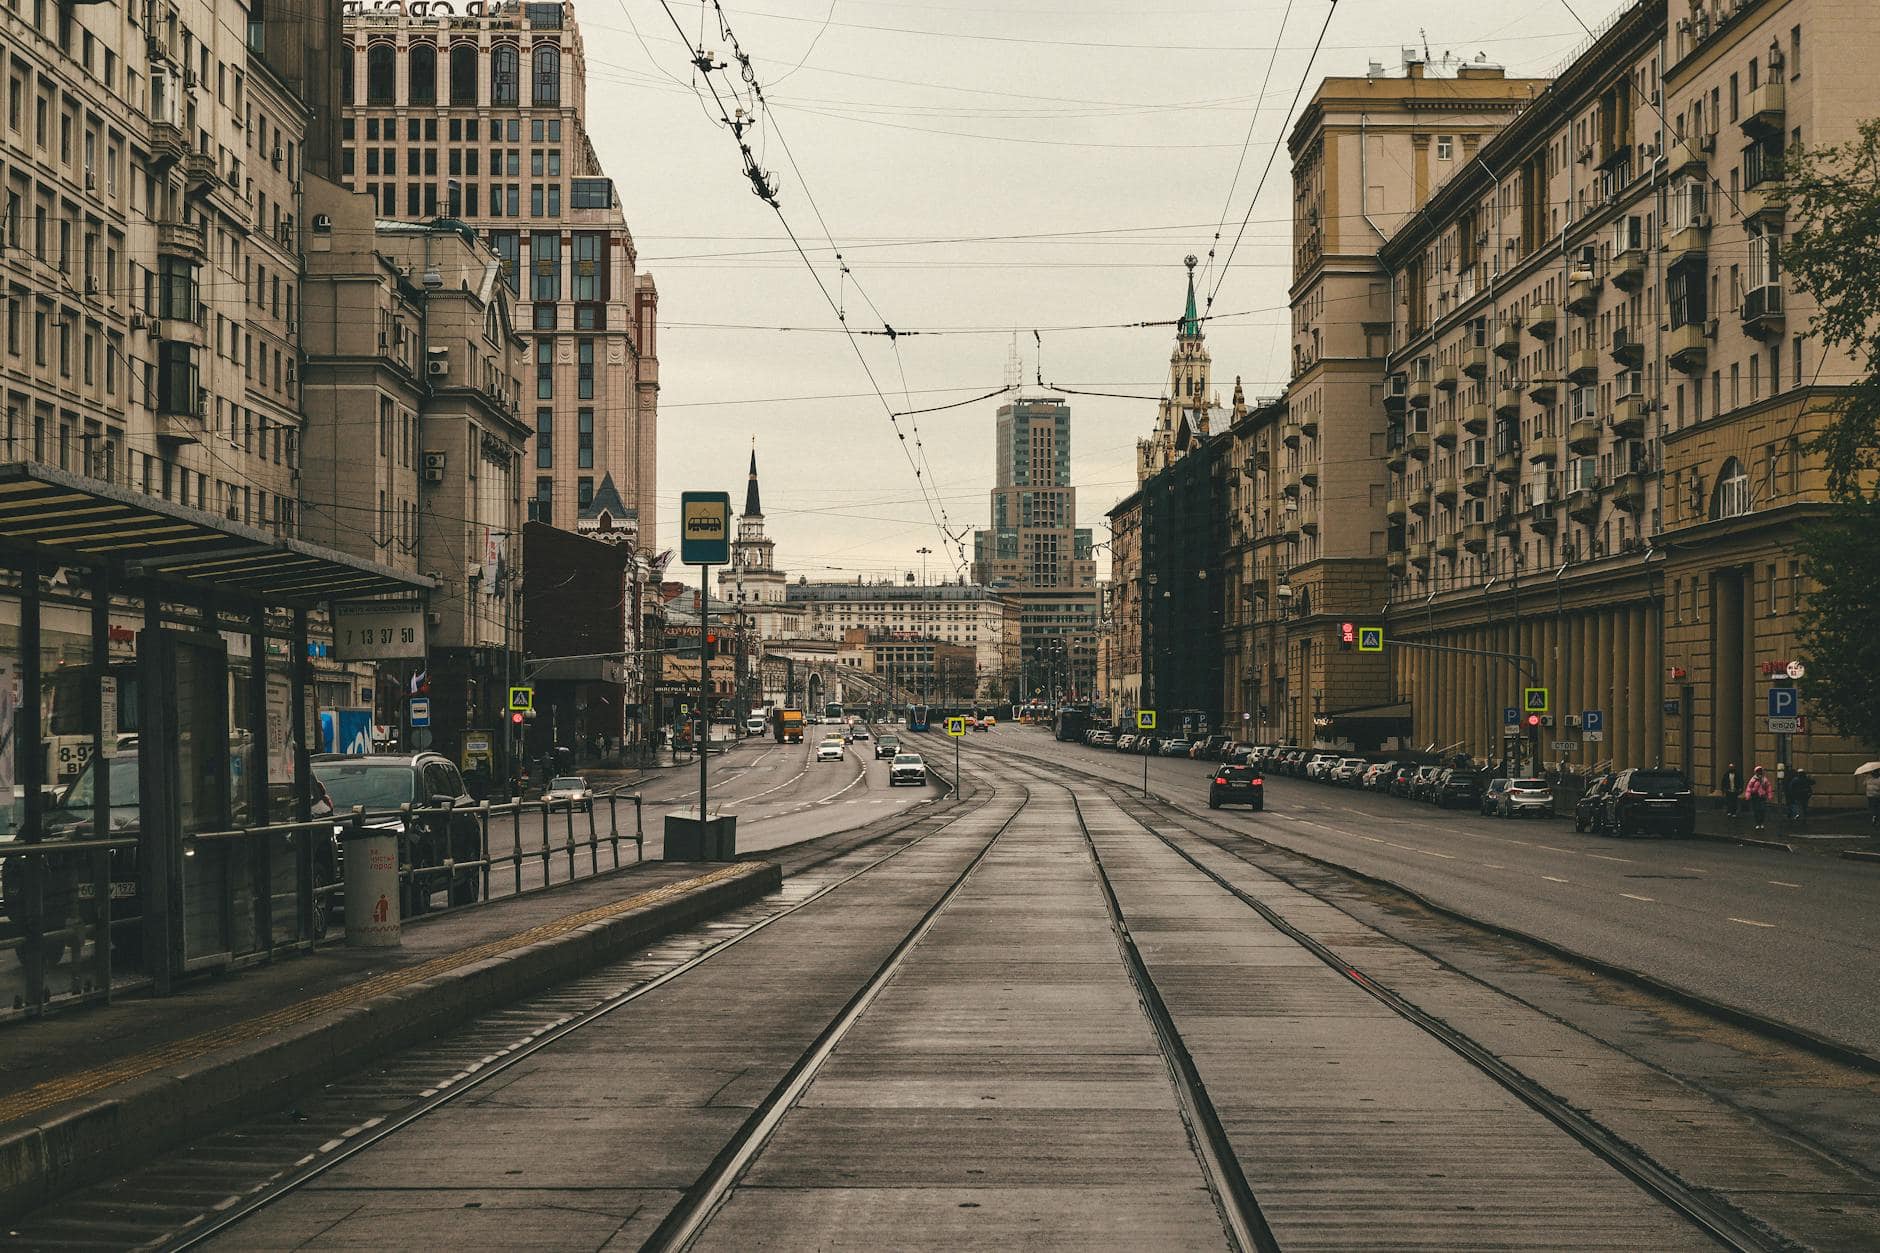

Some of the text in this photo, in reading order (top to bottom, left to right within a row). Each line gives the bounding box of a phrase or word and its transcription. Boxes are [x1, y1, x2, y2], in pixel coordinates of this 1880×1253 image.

[346, 627, 414, 645] 7 13 37 50
[1777, 692, 1791, 714] P
[1508, 710, 1516, 722] P
[1588, 714, 1598, 728] P
